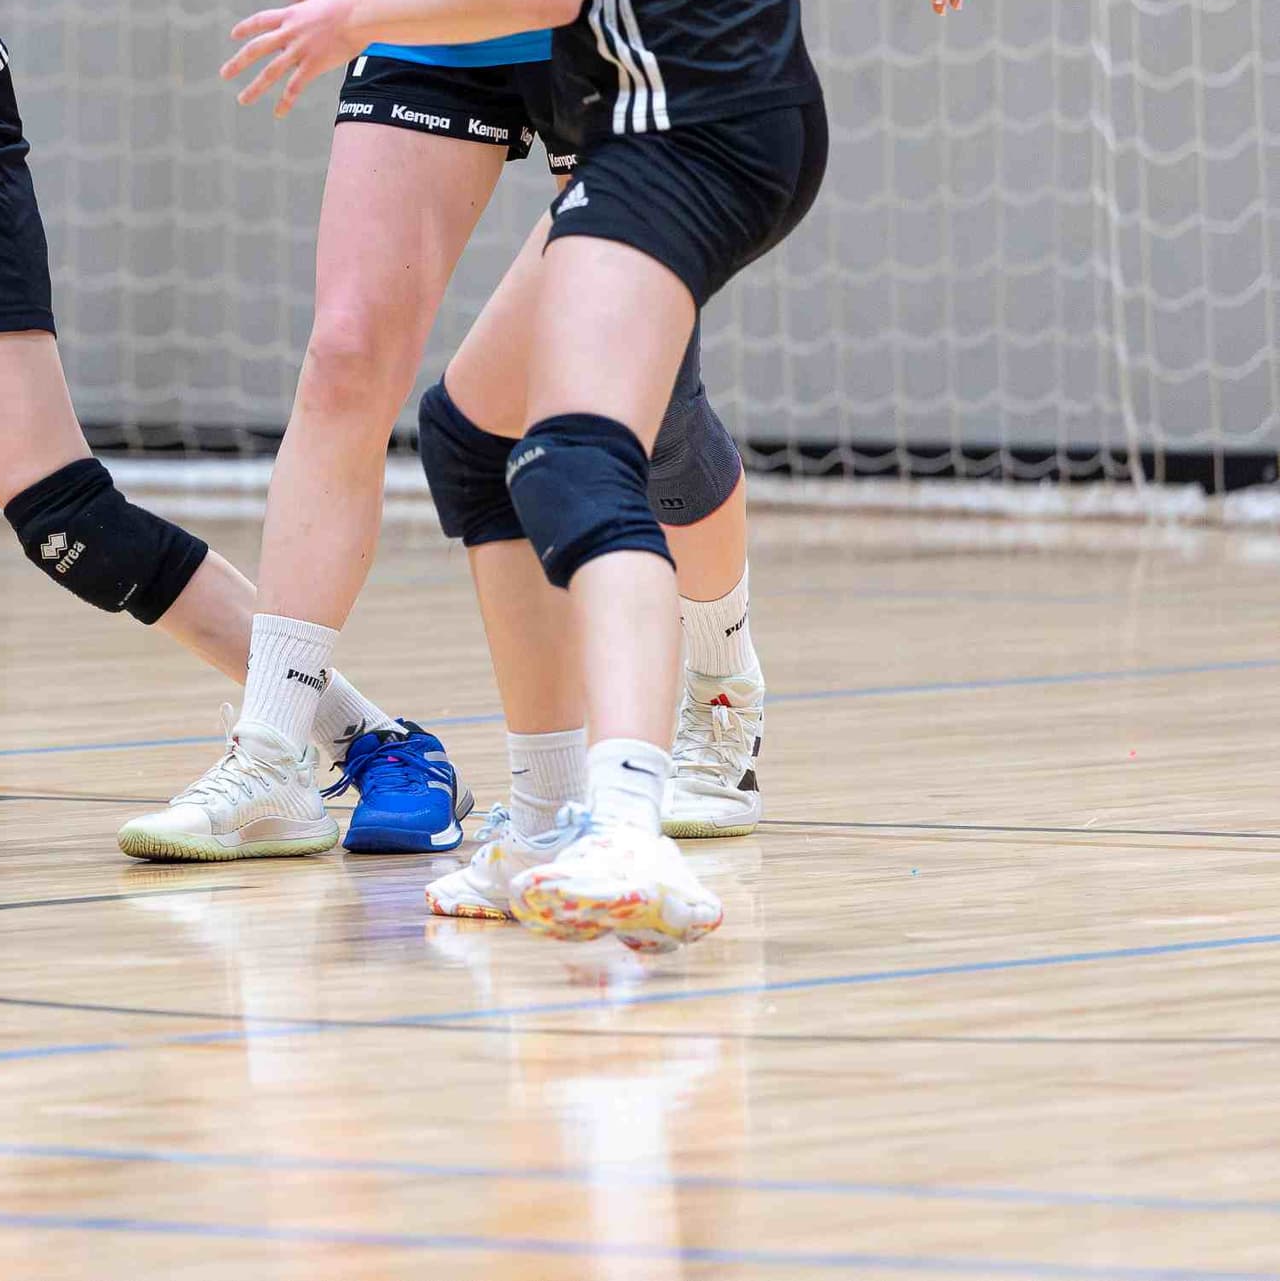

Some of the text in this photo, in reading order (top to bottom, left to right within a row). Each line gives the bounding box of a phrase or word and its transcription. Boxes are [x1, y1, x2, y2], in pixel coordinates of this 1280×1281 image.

[391, 104, 450, 129] Kempa
[468, 118, 508, 142] Kempa
[286, 668, 324, 694] PUMA
